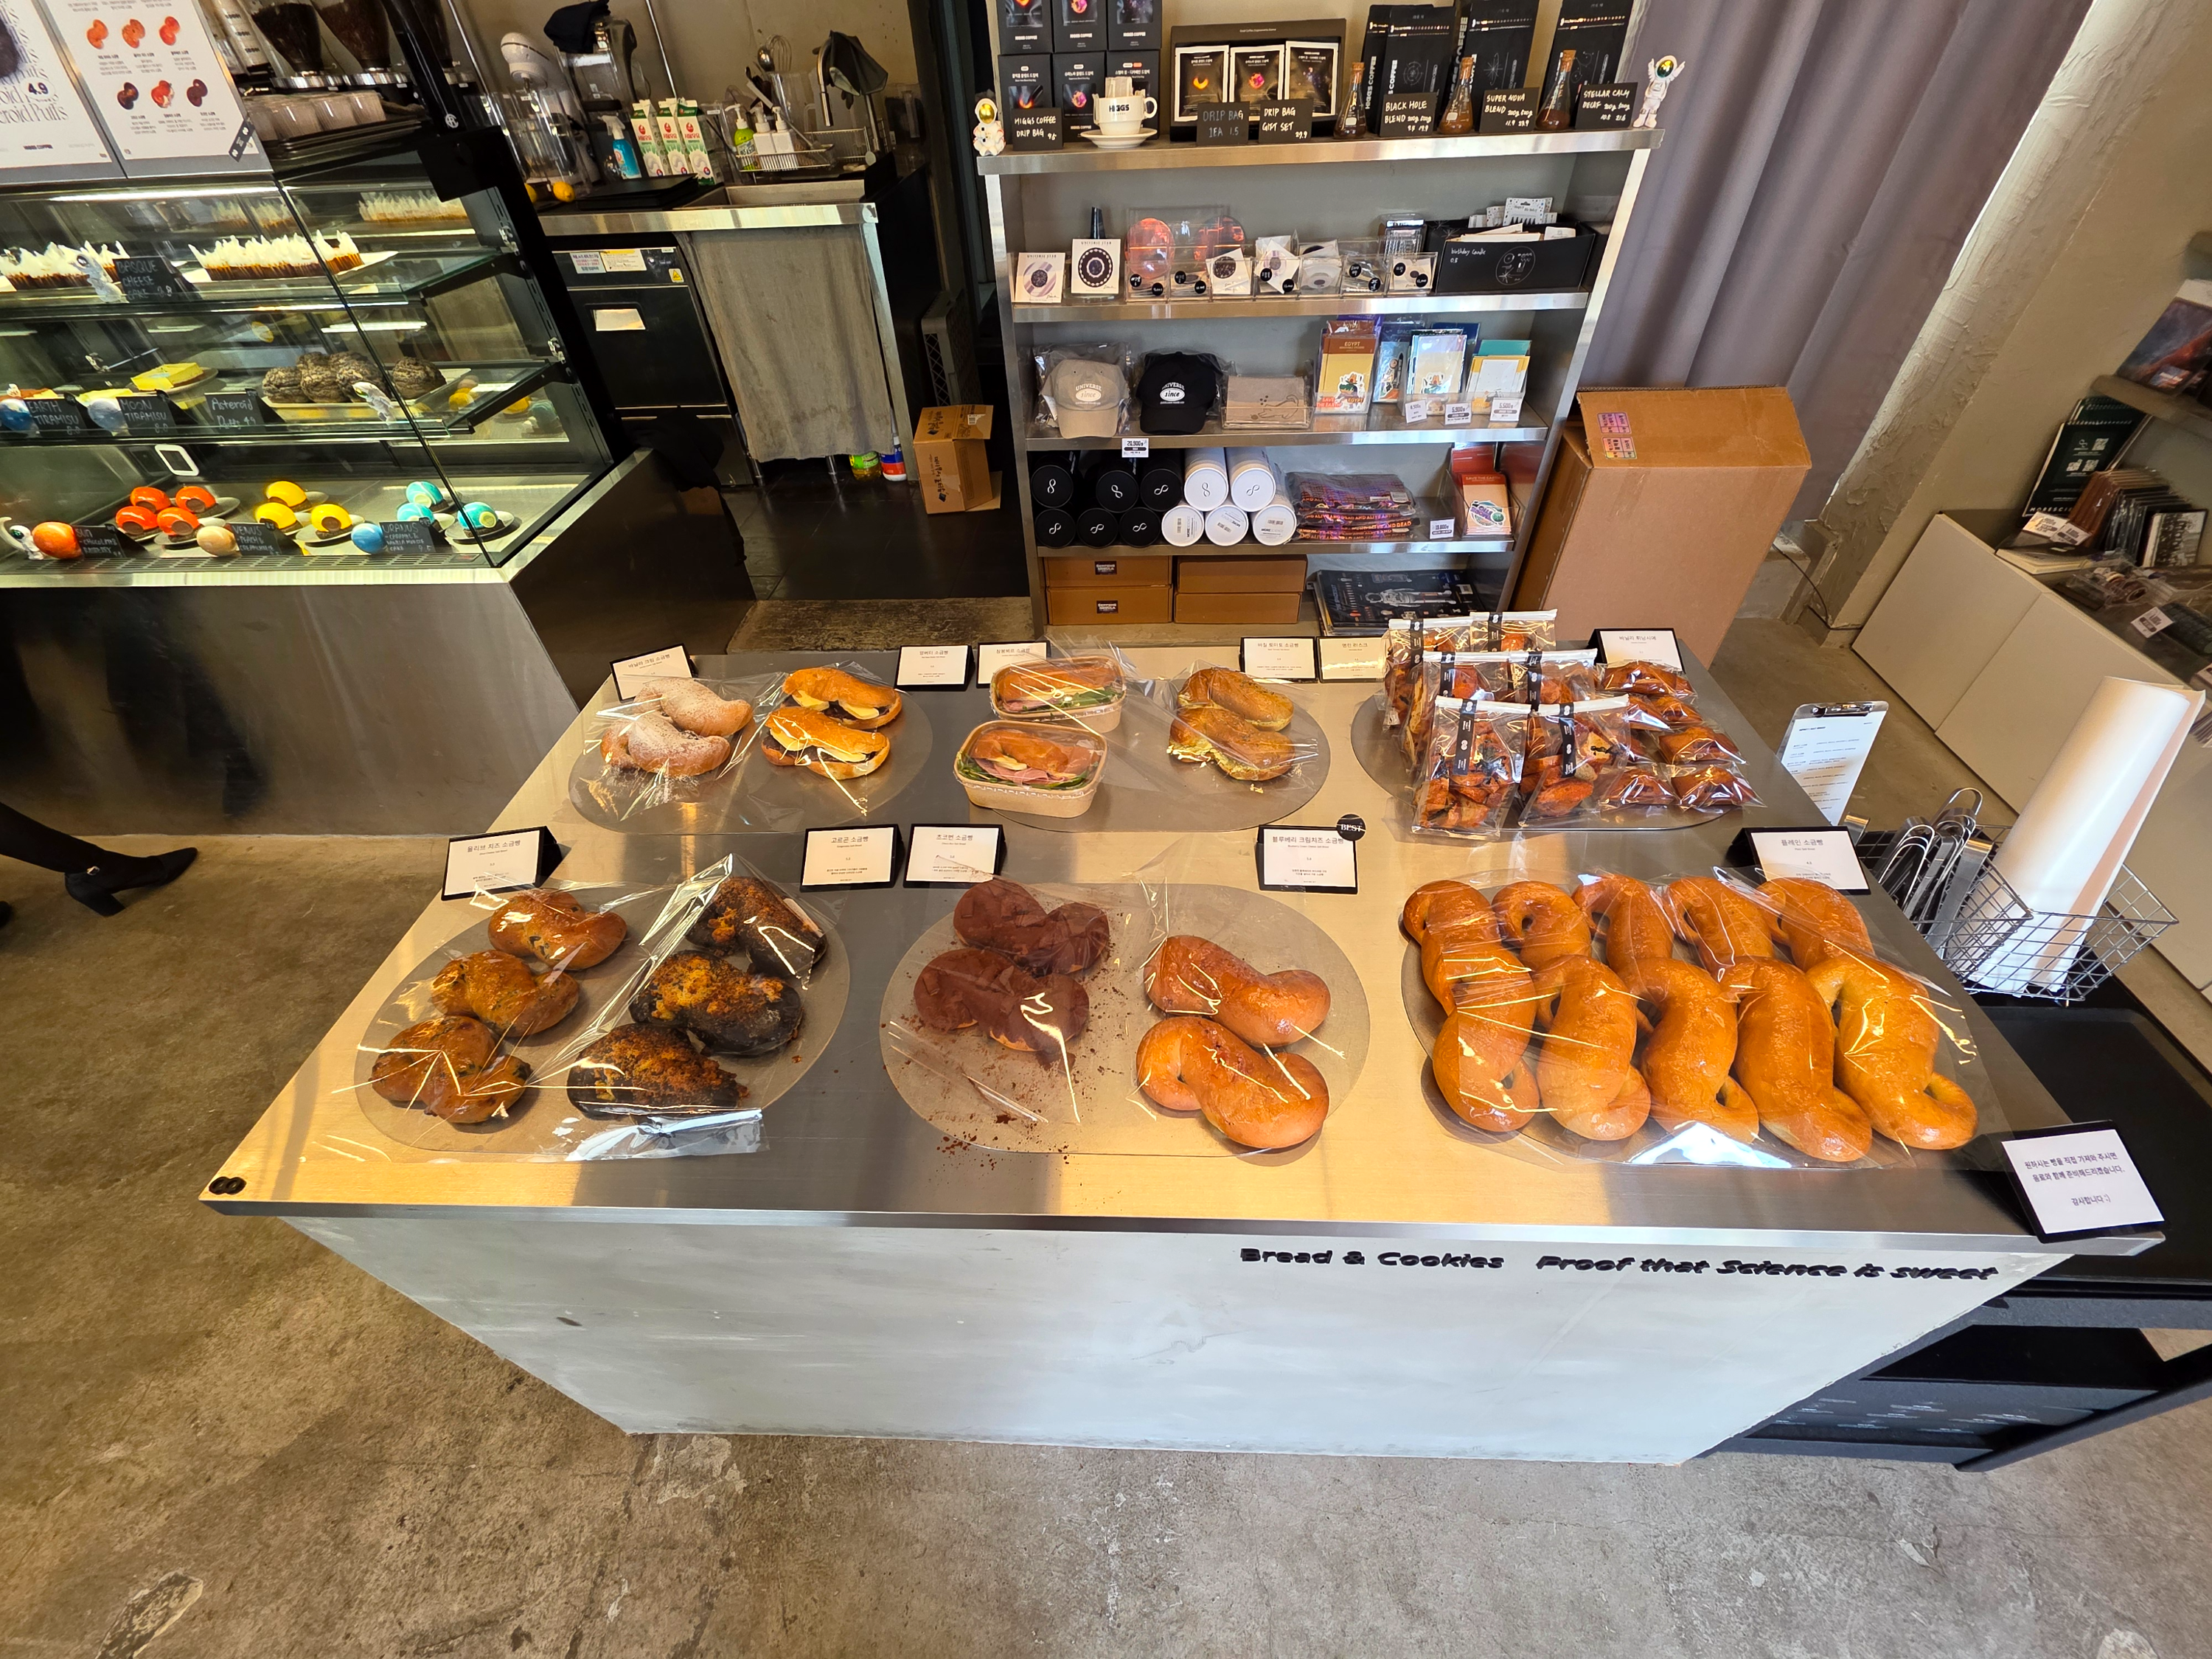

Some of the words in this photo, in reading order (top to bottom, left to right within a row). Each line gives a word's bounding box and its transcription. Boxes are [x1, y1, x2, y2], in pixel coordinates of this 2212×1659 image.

[1455, 17, 1468, 63] COFFEE
[1368, 56, 1377, 85] COFFEE
[1389, 60, 1397, 89] COFFEE
[28, 83, 49, 95] 4.9
[1584, 90, 1610, 98] STELLAR
[1612, 90, 1630, 99] CALM
[1486, 94, 1507, 103] SUPER
[1508, 94, 1526, 102] NOVA
[1109, 104, 1130, 112] HIGGS
[1385, 101, 1407, 112] BLACK
[1408, 100, 1427, 110] HOLE
[1485, 105, 1506, 114] BLEND
[1582, 101, 1601, 109] DECAF
[1203, 111, 1225, 122] DRIP
[1228, 110, 1244, 121] BAG
[1264, 108, 1280, 116] DRIP
[1281, 107, 1296, 116] BAG
[1015, 116, 1034, 125] HIGGS
[1036, 116, 1056, 124] COFFEE
[1384, 114, 1405, 124] BLEND
[1262, 122, 1278, 131] GIFT
[1280, 122, 1293, 131] SET
[1016, 129, 1029, 137] DRIP
[1032, 128, 1044, 137] BAG
[1209, 127, 1223, 138] 1EA
[1230, 127, 1239, 136] 1.5
[116, 260, 158, 274] BASQUE
[122, 276, 155, 288] CHEESE
[128, 289, 149, 301] CAKE
[1075, 383, 1102, 391] UNIVERSE
[27, 400, 62, 414] EARTH
[119, 399, 153, 411] MOON
[211, 397, 254, 410] Asteroid
[35, 414, 80, 425] TIRAMISU
[124, 412, 167, 422] TIRAMISU
[232, 525, 262, 536] VENUS
[382, 523, 419, 533] URANUS
[655, 653, 671, 662] 소금빵
[467, 844, 486, 852] 올리브
[502, 840, 521, 848] 소금빵
[2025, 1160, 2050, 1169] 원하시는
[2050, 1158, 2063, 1166] 빵을
[2065, 1156, 2078, 1165] 직접
[2098, 1152, 2118, 1161] 주시면
[2032, 1172, 2052, 1183] 음료와
[2053, 1171, 2066, 1180] 함께
[2071, 1196, 2103, 1206] 감사합니다
[1240, 1248, 1332, 1264] Bread
[1343, 1251, 1365, 1265] &
[1377, 1252, 1505, 1268] Cookies
[1536, 1255, 1635, 1271] Proof
[1640, 1258, 1711, 1274] that
[1715, 1259, 1848, 1277] Science
[1889, 1267, 1999, 1280] sweet
